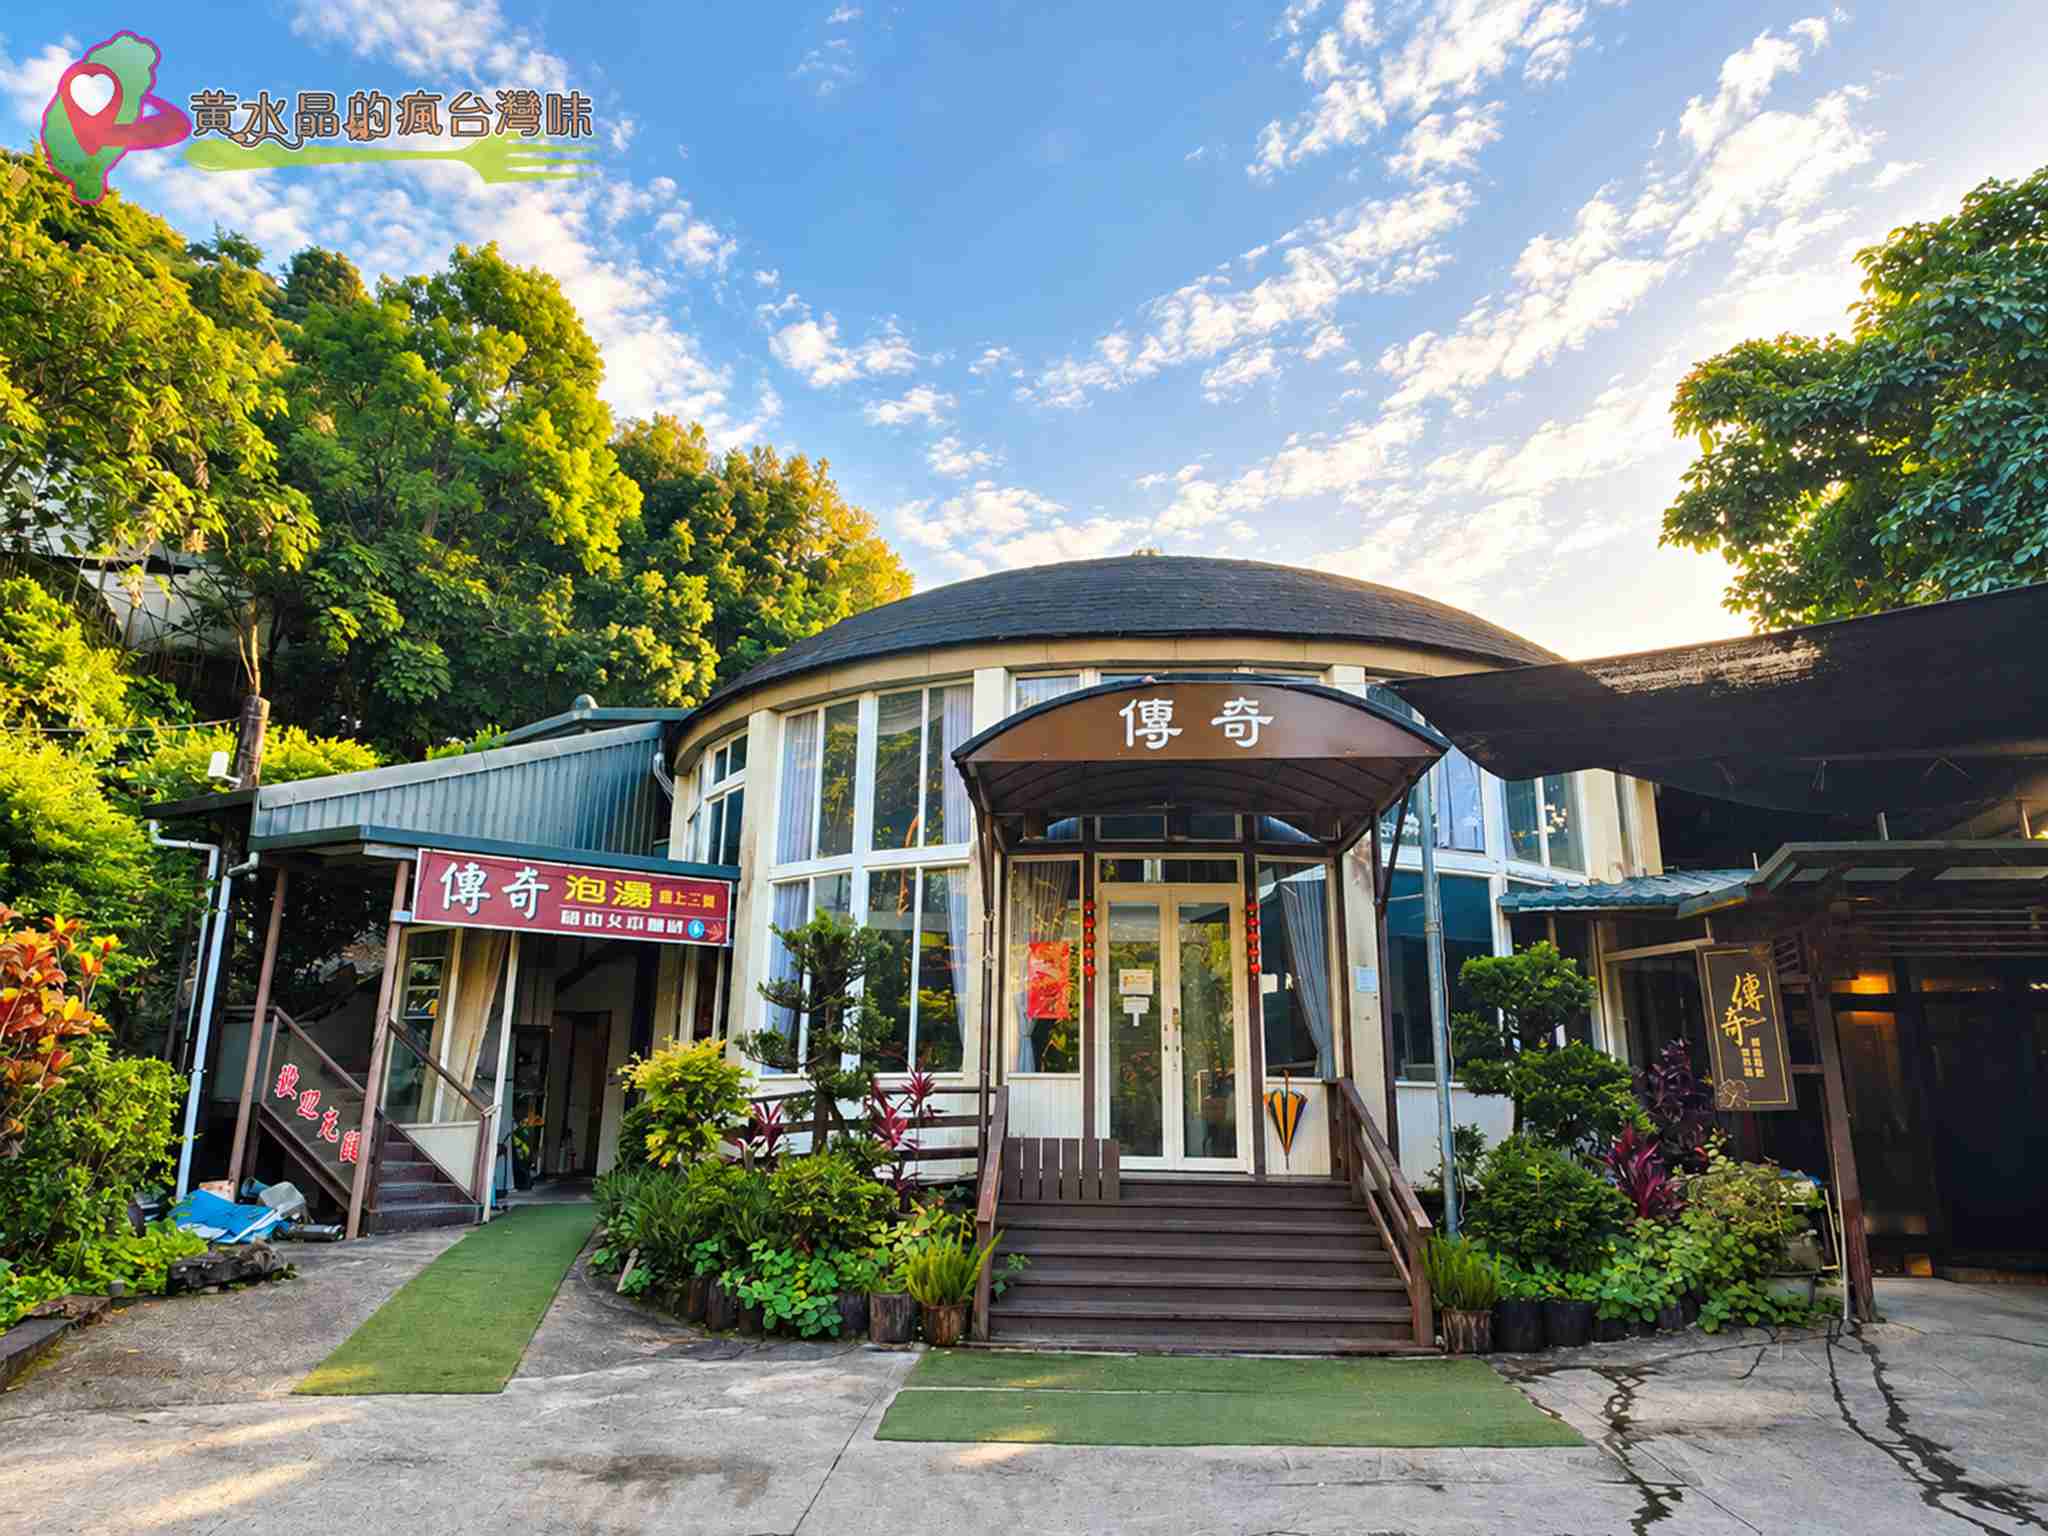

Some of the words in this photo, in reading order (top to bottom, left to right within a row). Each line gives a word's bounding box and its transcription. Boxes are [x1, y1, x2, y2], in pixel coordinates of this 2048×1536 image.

[1118, 696, 1275, 750] 傳奇
[440, 861, 550, 921] 傳奇
[564, 874, 654, 909] 泡湯
[1720, 972, 1767, 1047] 傳奇
